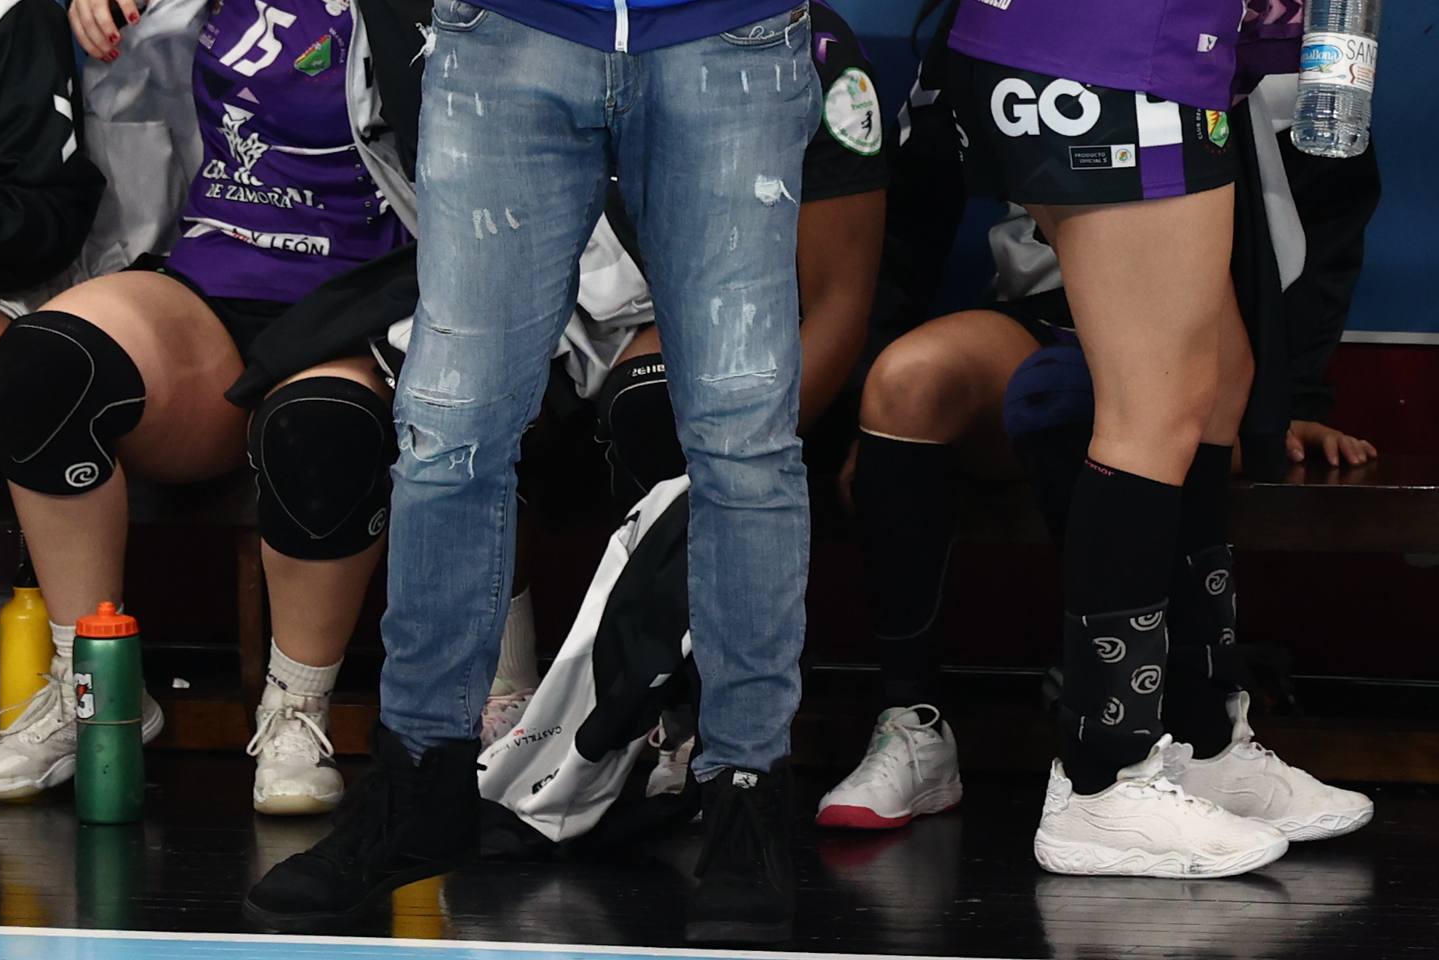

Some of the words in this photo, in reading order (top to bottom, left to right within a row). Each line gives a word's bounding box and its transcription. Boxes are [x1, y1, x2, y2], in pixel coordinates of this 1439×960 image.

[219, 0, 297, 77] 15
[991, 78, 1101, 137] GO
[225, 185, 293, 209] ZAMORA
